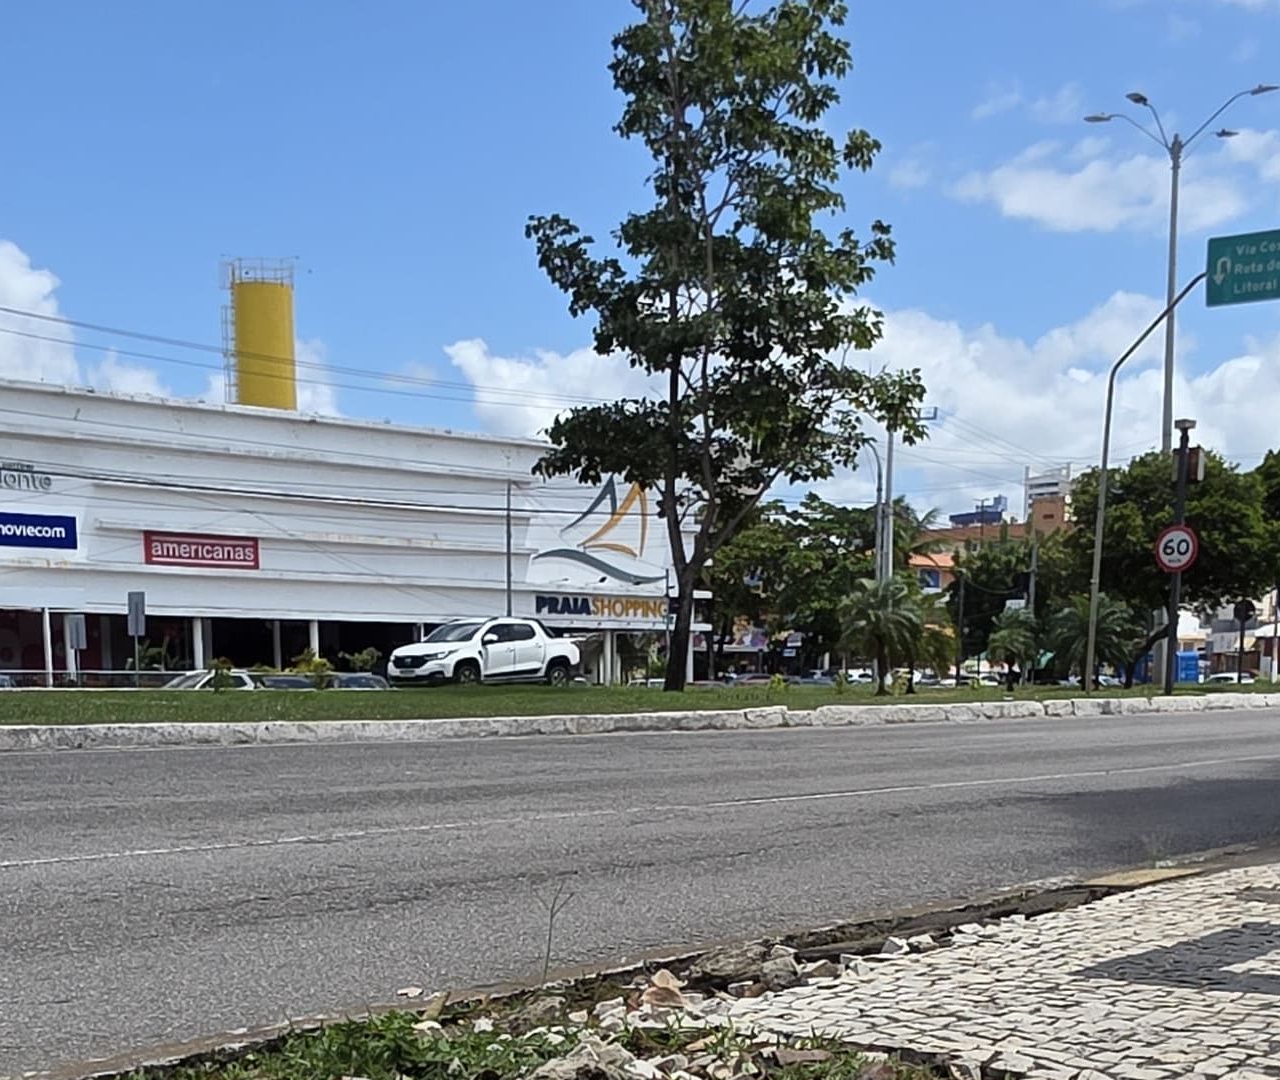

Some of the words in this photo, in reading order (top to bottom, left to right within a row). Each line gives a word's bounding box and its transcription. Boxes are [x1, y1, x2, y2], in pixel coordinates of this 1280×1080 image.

[1236, 245, 1257, 255] Via
[1234, 263, 1264, 275] Rota
[1234, 279, 1277, 294] Litoral
[152, 541, 254, 561] americanas
[1163, 538, 1190, 555] 60
[536, 595, 591, 615] PRAIA
[592, 597, 668, 618] SHOPPING
